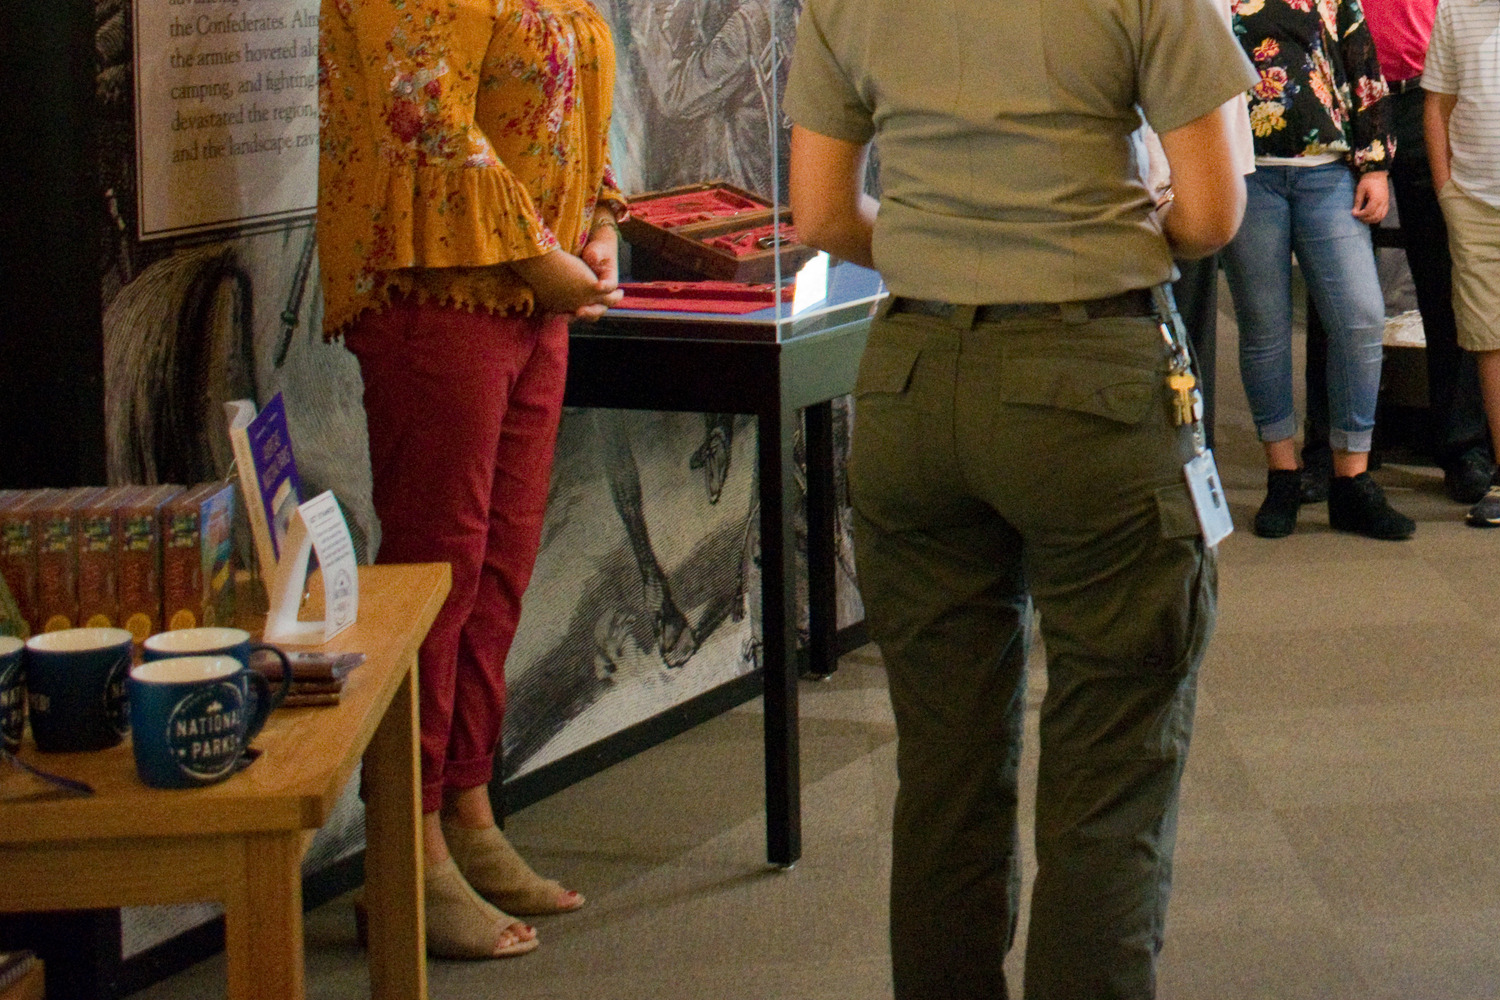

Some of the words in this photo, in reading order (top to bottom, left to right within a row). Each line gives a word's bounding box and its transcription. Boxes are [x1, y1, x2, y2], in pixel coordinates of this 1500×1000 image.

[170, 16, 193, 38] the
[196, 11, 288, 36] Confederates.
[170, 49, 193, 70] the
[197, 48, 241, 67] armies
[243, 39, 298, 64] hovered
[170, 80, 234, 103] camping,
[238, 73, 263, 95] and
[171, 104, 244, 132] devastated
[247, 102, 269, 124] the
[172, 139, 198, 164] and
[202, 138, 226, 159] the
[228, 132, 293, 157] landscape
